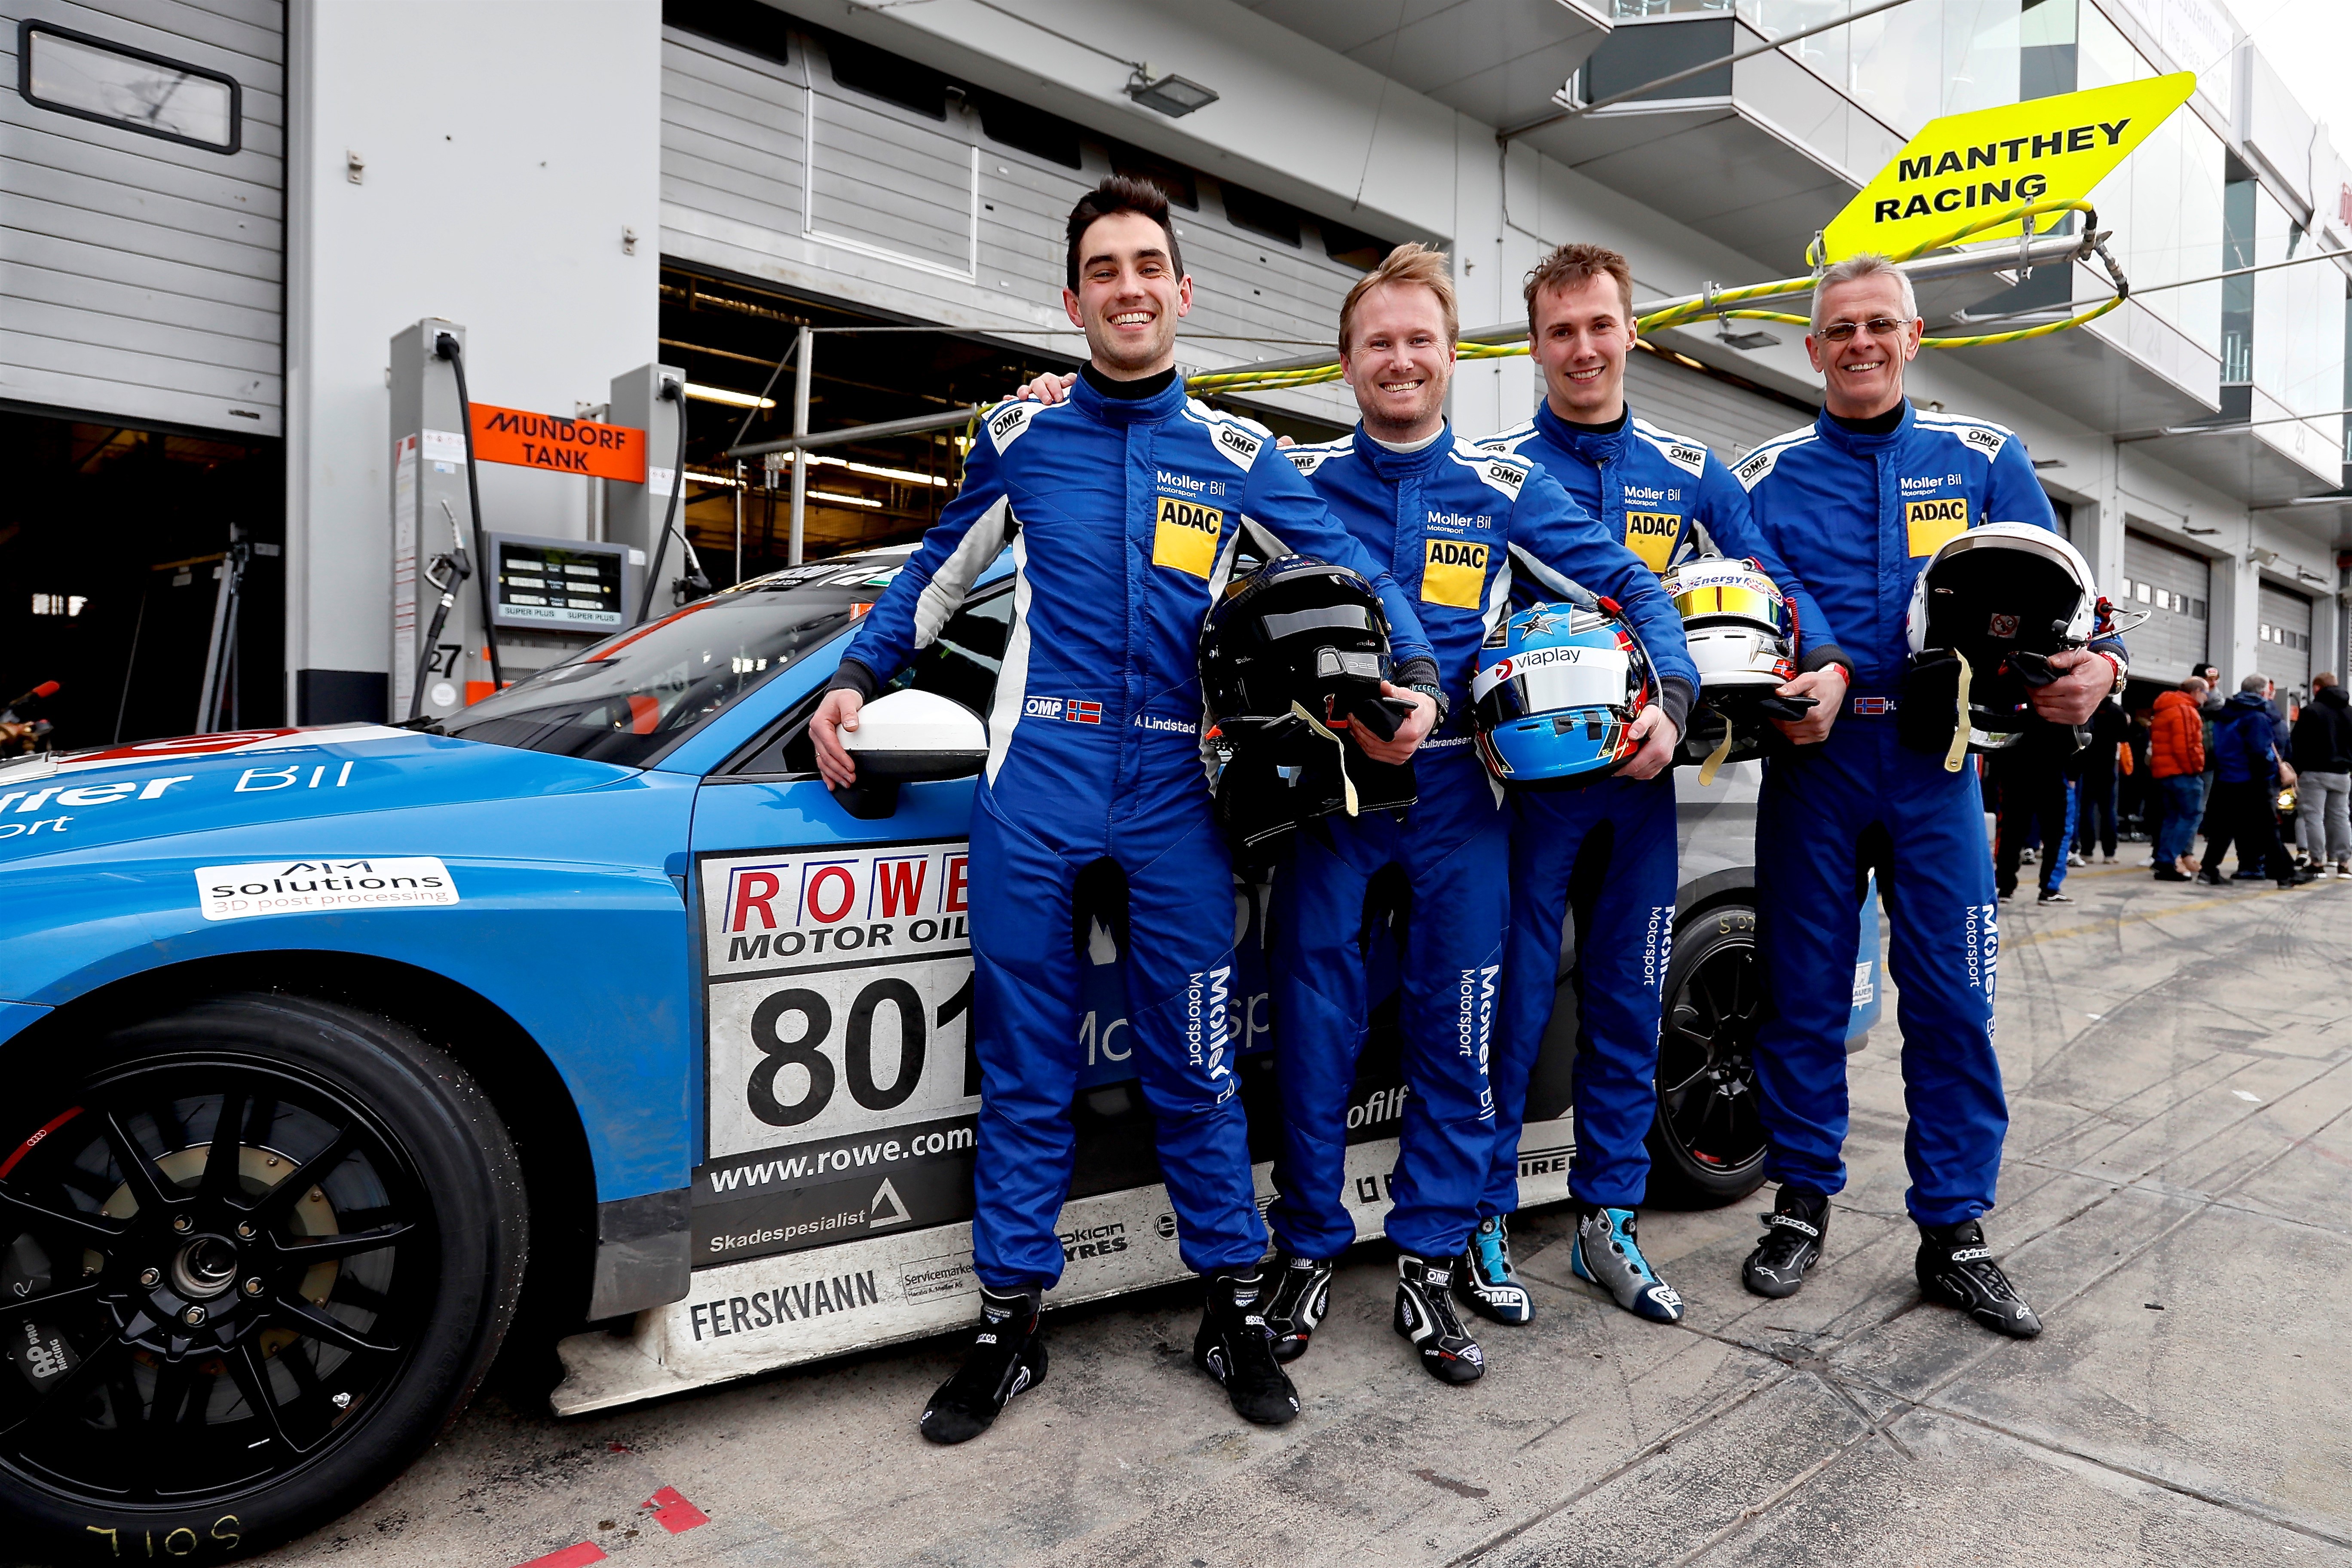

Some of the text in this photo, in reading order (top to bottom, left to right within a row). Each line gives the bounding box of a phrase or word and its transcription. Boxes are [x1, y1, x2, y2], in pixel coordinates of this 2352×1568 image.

[1899, 118, 2131, 182] MANTHEY
[1874, 174, 2048, 223] RACING
[484, 411, 626, 450] MUNDORF
[993, 409, 1024, 435] OMP
[1222, 430, 1257, 453] OMP
[1968, 430, 2000, 447] OMP
[524, 443, 588, 472] TANK
[1294, 457, 1315, 468] MP
[1670, 447, 1702, 462] OMP
[1742, 454, 1768, 478] OMP
[1157, 470, 1225, 496] Moller Bil
[1490, 466, 1522, 484] OMP
[1900, 473, 1962, 489] Moller Bil
[1156, 485, 1197, 499] Motorsport
[1624, 485, 1680, 501] Moller Bil
[1624, 498, 1658, 507] Motorsport
[1901, 487, 1936, 497] Motorsport
[1161, 501, 1219, 535] ADAC
[1427, 511, 1491, 530] Moller Bil
[1910, 501, 1964, 521] ADAC
[1427, 525, 1464, 535] Motorsport
[1629, 515, 1678, 537] ADAC
[1429, 542, 1485, 569] ADAC
[504, 607, 531, 616] SUPER
[567, 611, 614, 622] SUPER PLUS
[429, 645, 462, 678] 27
[1516, 646, 1580, 669] viaplay
[1026, 698, 1062, 717] OMP
[1885, 700, 1897, 710] H.
[1134, 715, 1196, 734] A. Lindstad
[235, 761, 354, 792] Bil
[211, 874, 444, 898] solutions
[732, 858, 969, 932] ROWE
[214, 888, 449, 913] 3D post processing
[728, 923, 892, 962] MOTOR
[1642, 906, 1662, 986] Motorsport
[1660, 904, 1676, 1002] Moll
[1965, 906, 1981, 988] Motorsport
[1982, 903, 1999, 1005] Moller
[1185, 972, 1204, 1066] Motorsport
[1208, 965, 1231, 1080] Moller
[1457, 968, 1476, 1057] Motorsport
[1479, 964, 1500, 1075] Moller
[747, 970, 982, 1127] 801
[710, 1208, 866, 1253] Skadespesialist
[1064, 1237, 1128, 1262] YRES
[1290, 1257, 1313, 1267] OMP
[1427, 1271, 1449, 1283] OMP
[690, 1270, 879, 1342] FERSKVANN
[49, 1338, 68, 1371] RACING
